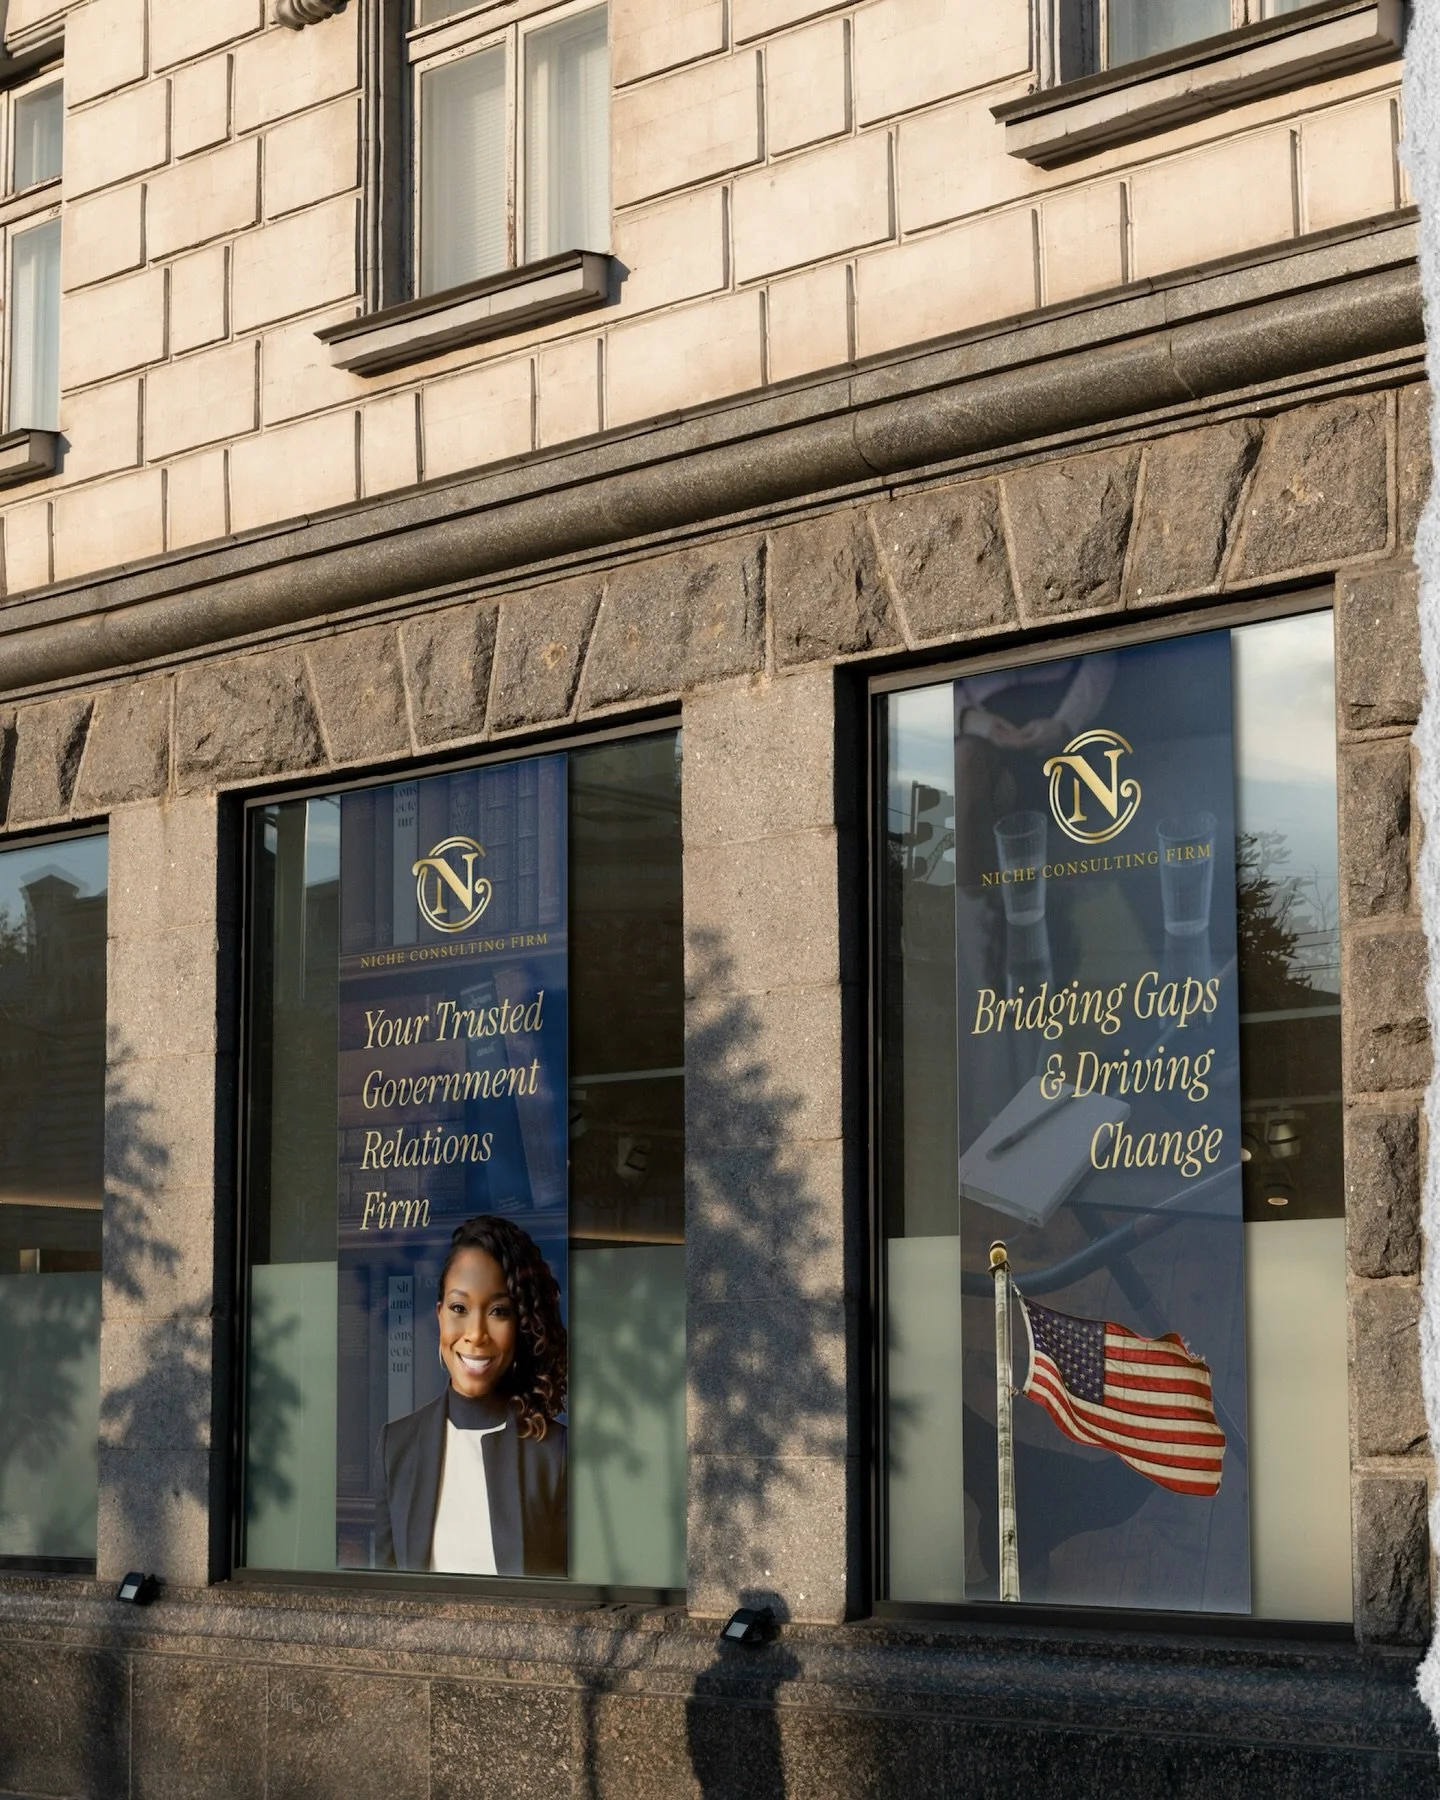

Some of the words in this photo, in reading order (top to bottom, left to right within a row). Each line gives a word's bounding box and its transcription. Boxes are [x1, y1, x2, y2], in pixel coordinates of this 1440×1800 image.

[981, 867, 1036, 887] NICHE
[1042, 851, 1159, 879] CONSULTING
[1165, 843, 1212, 863] FIRM
[360, 951, 405, 968] NICHE
[410, 938, 505, 961] CONSULTING
[511, 932, 548, 948] FIRM
[363, 1009, 430, 1049] Your
[435, 989, 545, 1042] Trusted
[971, 980, 1127, 1040] Bridging
[1133, 971, 1220, 1028] Gaps
[362, 1058, 540, 1110] Government
[1040, 1053, 1066, 1100] &
[1071, 1045, 1216, 1102] Driving
[360, 1126, 493, 1170] Relations
[1089, 1120, 1224, 1178] Change
[360, 1191, 431, 1231] Firm
